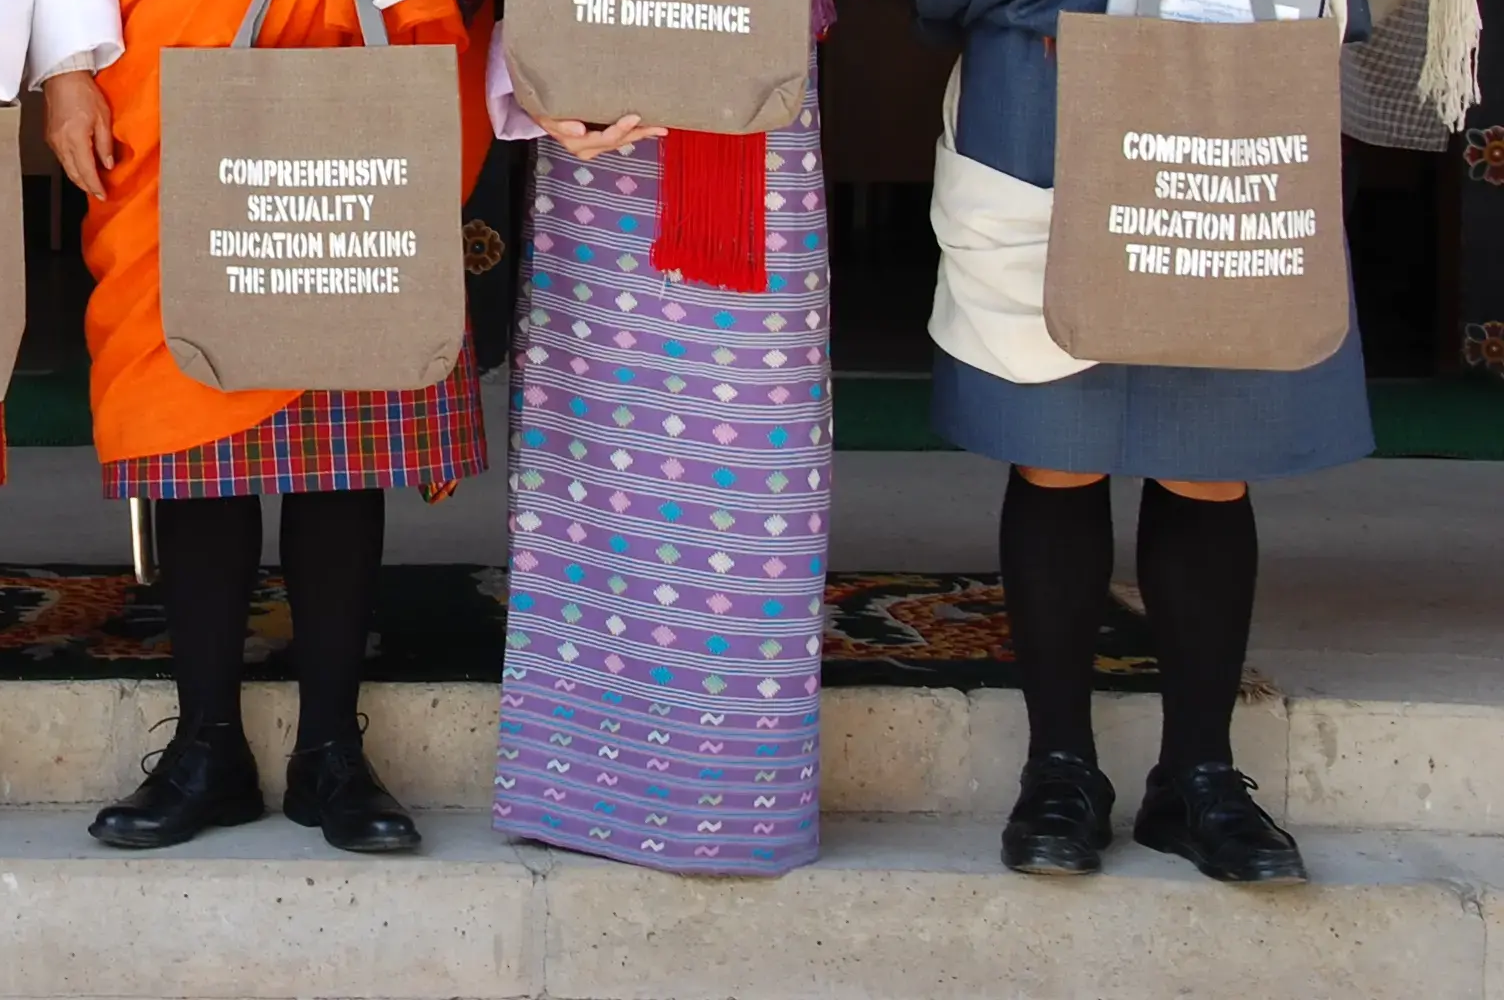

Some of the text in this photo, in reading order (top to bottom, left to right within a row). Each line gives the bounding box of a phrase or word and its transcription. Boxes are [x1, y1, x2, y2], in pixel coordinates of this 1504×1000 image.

[620, 0, 750, 34] DIFFERENCE
[1123, 131, 1309, 168] COMPREHENSIVE
[219, 158, 408, 187] COMPREHENSIVE
[1154, 170, 1278, 204] SEXUALITY
[247, 194, 374, 222] SEXUALITY
[1109, 204, 1316, 241] EDUCATION MAKING
[209, 229, 416, 259] EDUCATION MAKING
[1125, 243, 1304, 278] THE DIFFERENCE
[226, 266, 400, 294] THE DIFFERENCE
